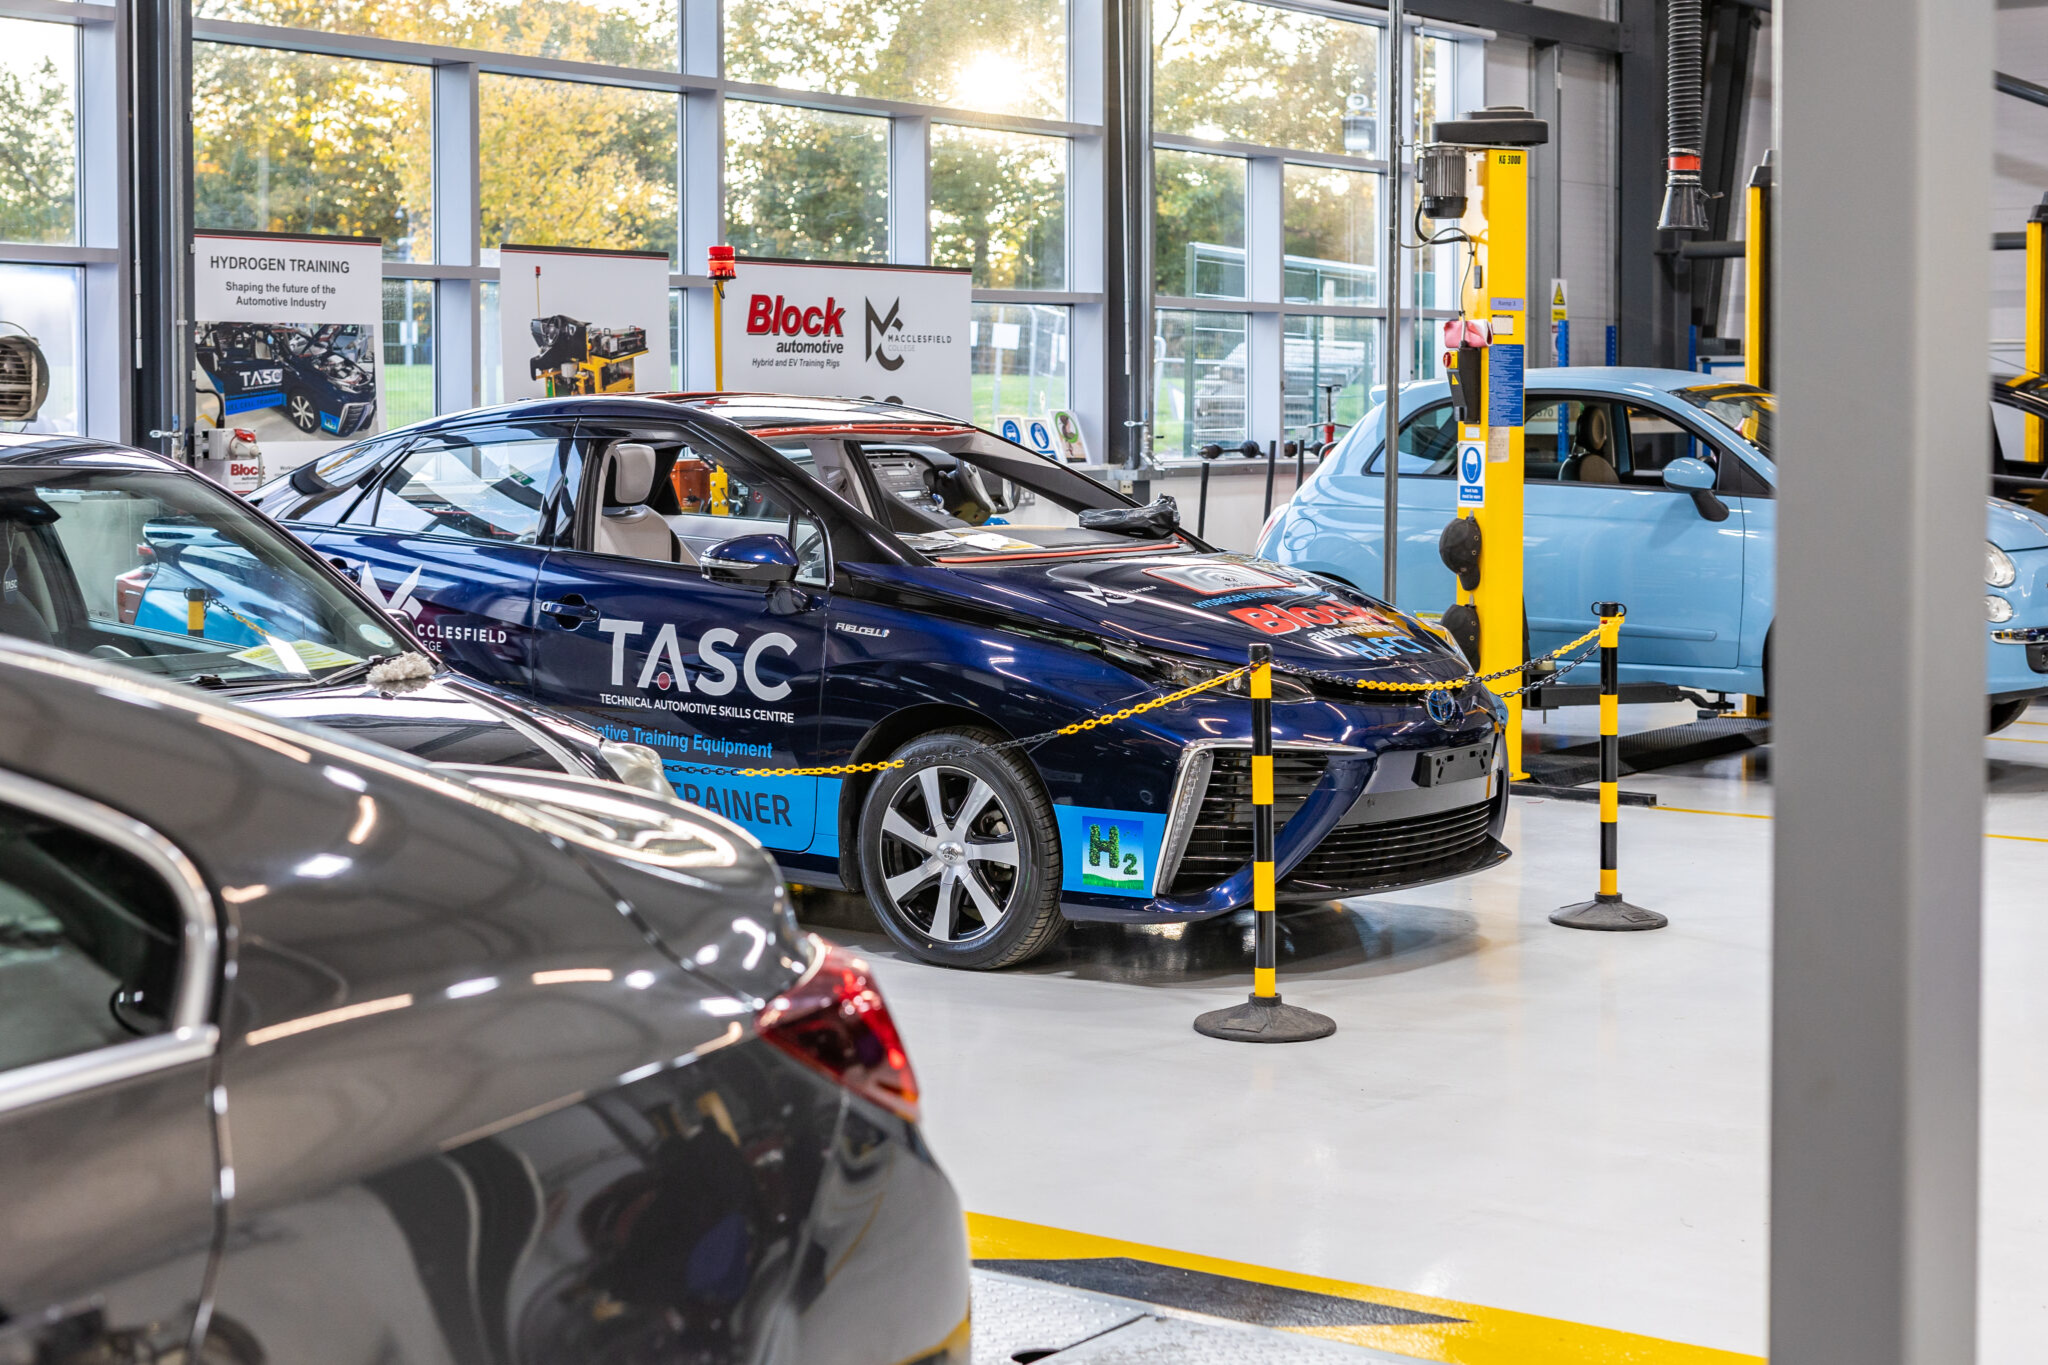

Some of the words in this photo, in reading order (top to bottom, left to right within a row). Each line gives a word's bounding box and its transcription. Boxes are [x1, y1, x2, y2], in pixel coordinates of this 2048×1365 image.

[1498, 155, 1506, 165] KG
[1507, 155, 1521, 165] 3000
[210, 255, 286, 271] HYDROGEN
[289, 258, 350, 274] TRAINING
[225, 281, 264, 294] Shaping
[266, 282, 280, 293] the
[282, 283, 309, 294] future
[311, 283, 320, 294] of
[322, 284, 336, 294] the
[236, 295, 288, 307] Automotive
[290, 297, 327, 310] Industry
[746, 294, 846, 337] Block
[776, 339, 844, 354] automotive
[887, 334, 952, 344] MACCLESFIELD
[887, 344, 916, 352] COLLEGE
[752, 358, 774, 368] Hybrid
[775, 359, 787, 367] and
[788, 359, 797, 367] EV
[799, 359, 825, 369] Training
[826, 360, 840, 369] Rigs
[239, 369, 282, 387] TASC
[1227, 600, 1396, 637] Block
[417, 623, 507, 644] CCLESFIELD
[1307, 623, 1400, 641] automotive
[598, 618, 798, 701] TASC
[600, 693, 652, 709] TECHNICAL
[653, 699, 717, 716] AUTOMOTIVE
[718, 705, 751, 719] SKILLS
[752, 709, 795, 724] CENTRE
[632, 727, 689, 753] Training
[693, 734, 773, 759] Equipment
[1088, 823, 1139, 876] H2
